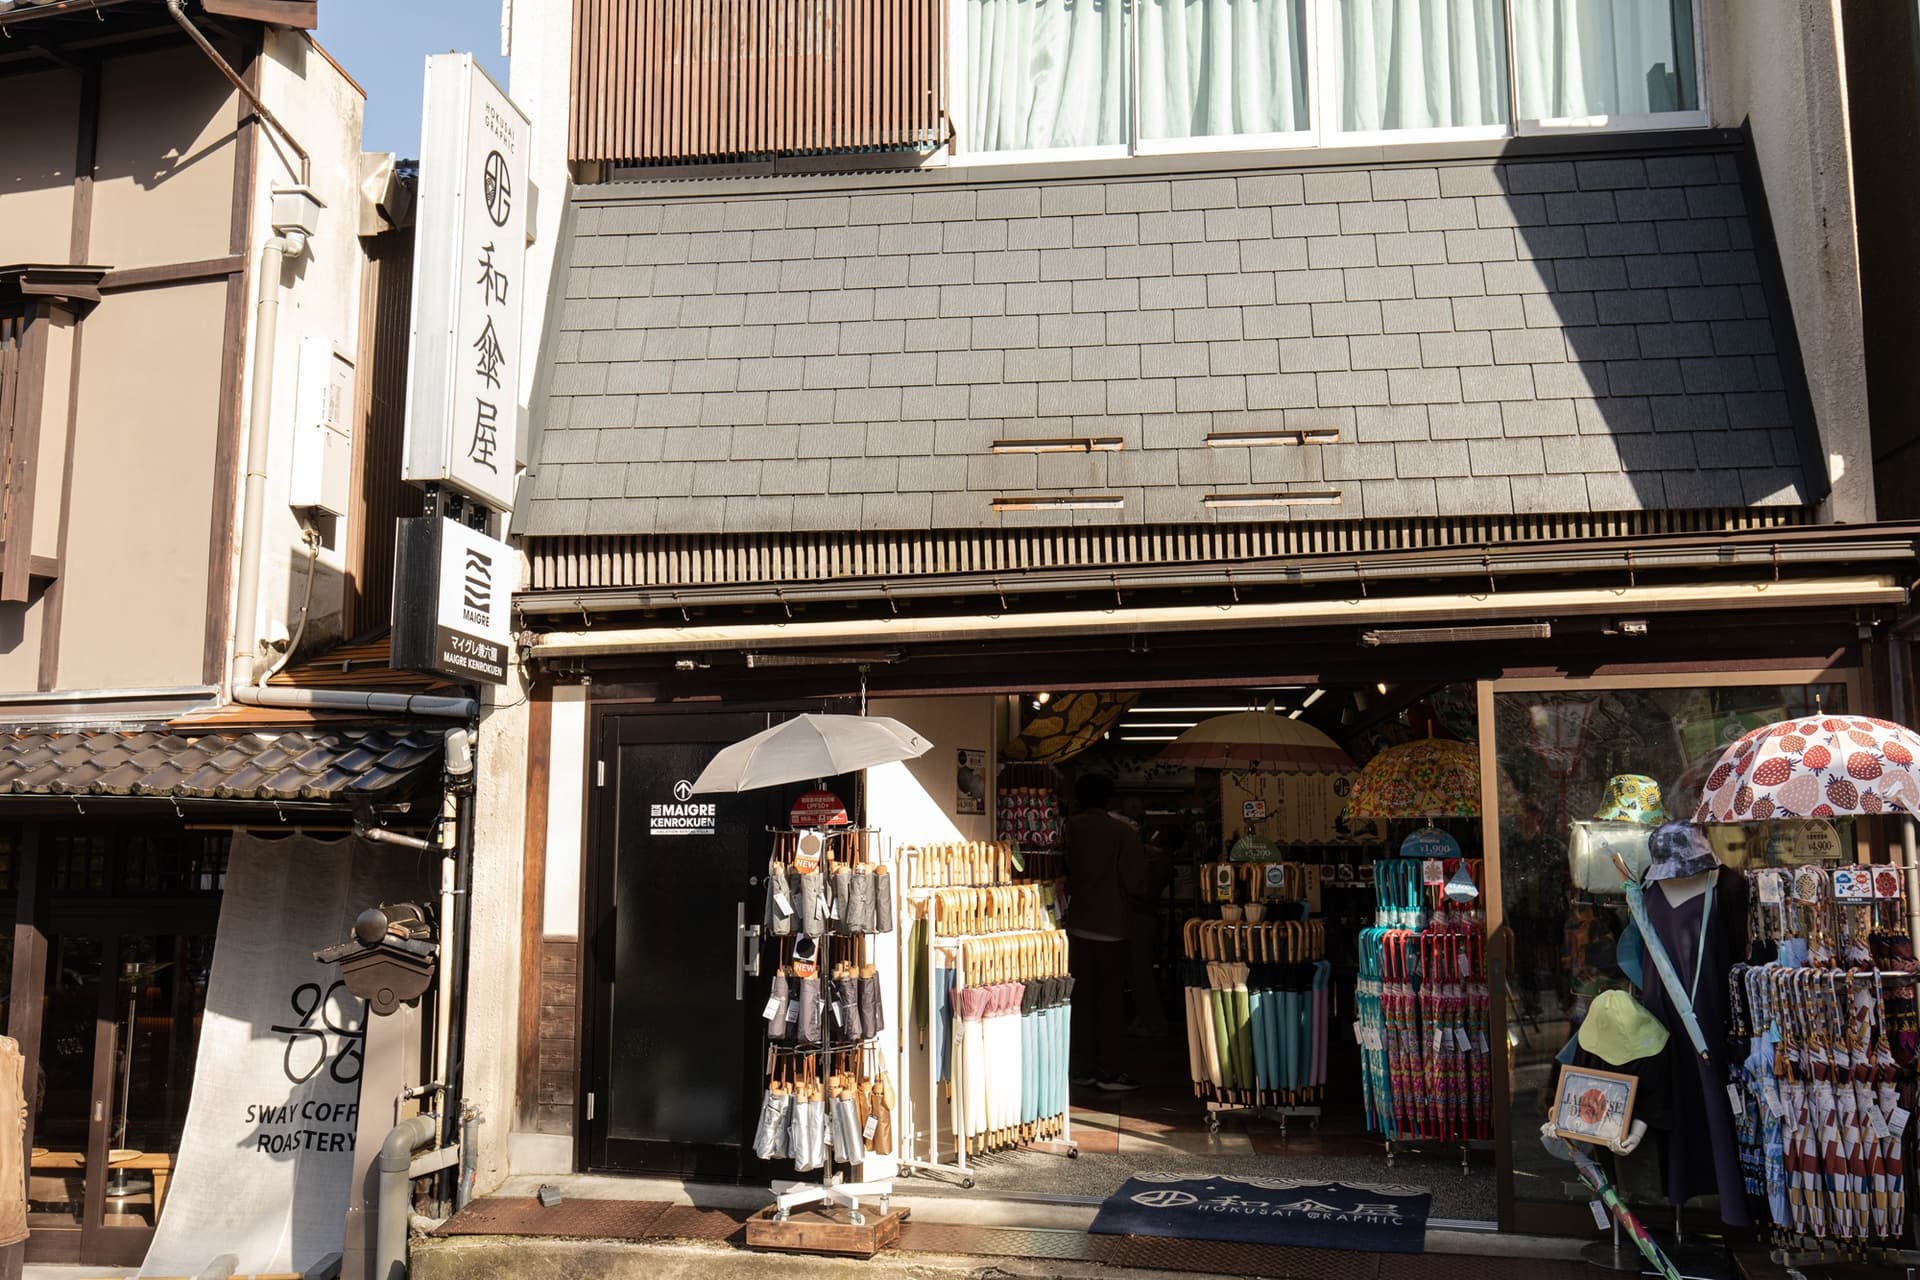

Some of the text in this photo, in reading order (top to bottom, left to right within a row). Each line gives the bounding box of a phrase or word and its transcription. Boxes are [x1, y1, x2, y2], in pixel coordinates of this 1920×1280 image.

[485, 101, 515, 141] HOKUSAI
[484, 115, 515, 155] GRAPHIC
[467, 240, 509, 475] 和傘屋
[463, 608, 490, 628] MAIGRE
[451, 635, 498, 663] マイグレ兼六園
[443, 651, 503, 677] MAIGRE KENROKUEN
[662, 803, 716, 816] MAIGRE
[650, 817, 716, 828] KENROKUEN
[797, 860, 816, 869] NEW
[796, 963, 815, 972] NEW
[245, 1104, 298, 1124] SWAY
[257, 1129, 357, 1152] ROASTERY
[1197, 1204, 1404, 1226] HOKUSAI GRAPHIC
[1208, 1194, 1404, 1216] 和傘屋
